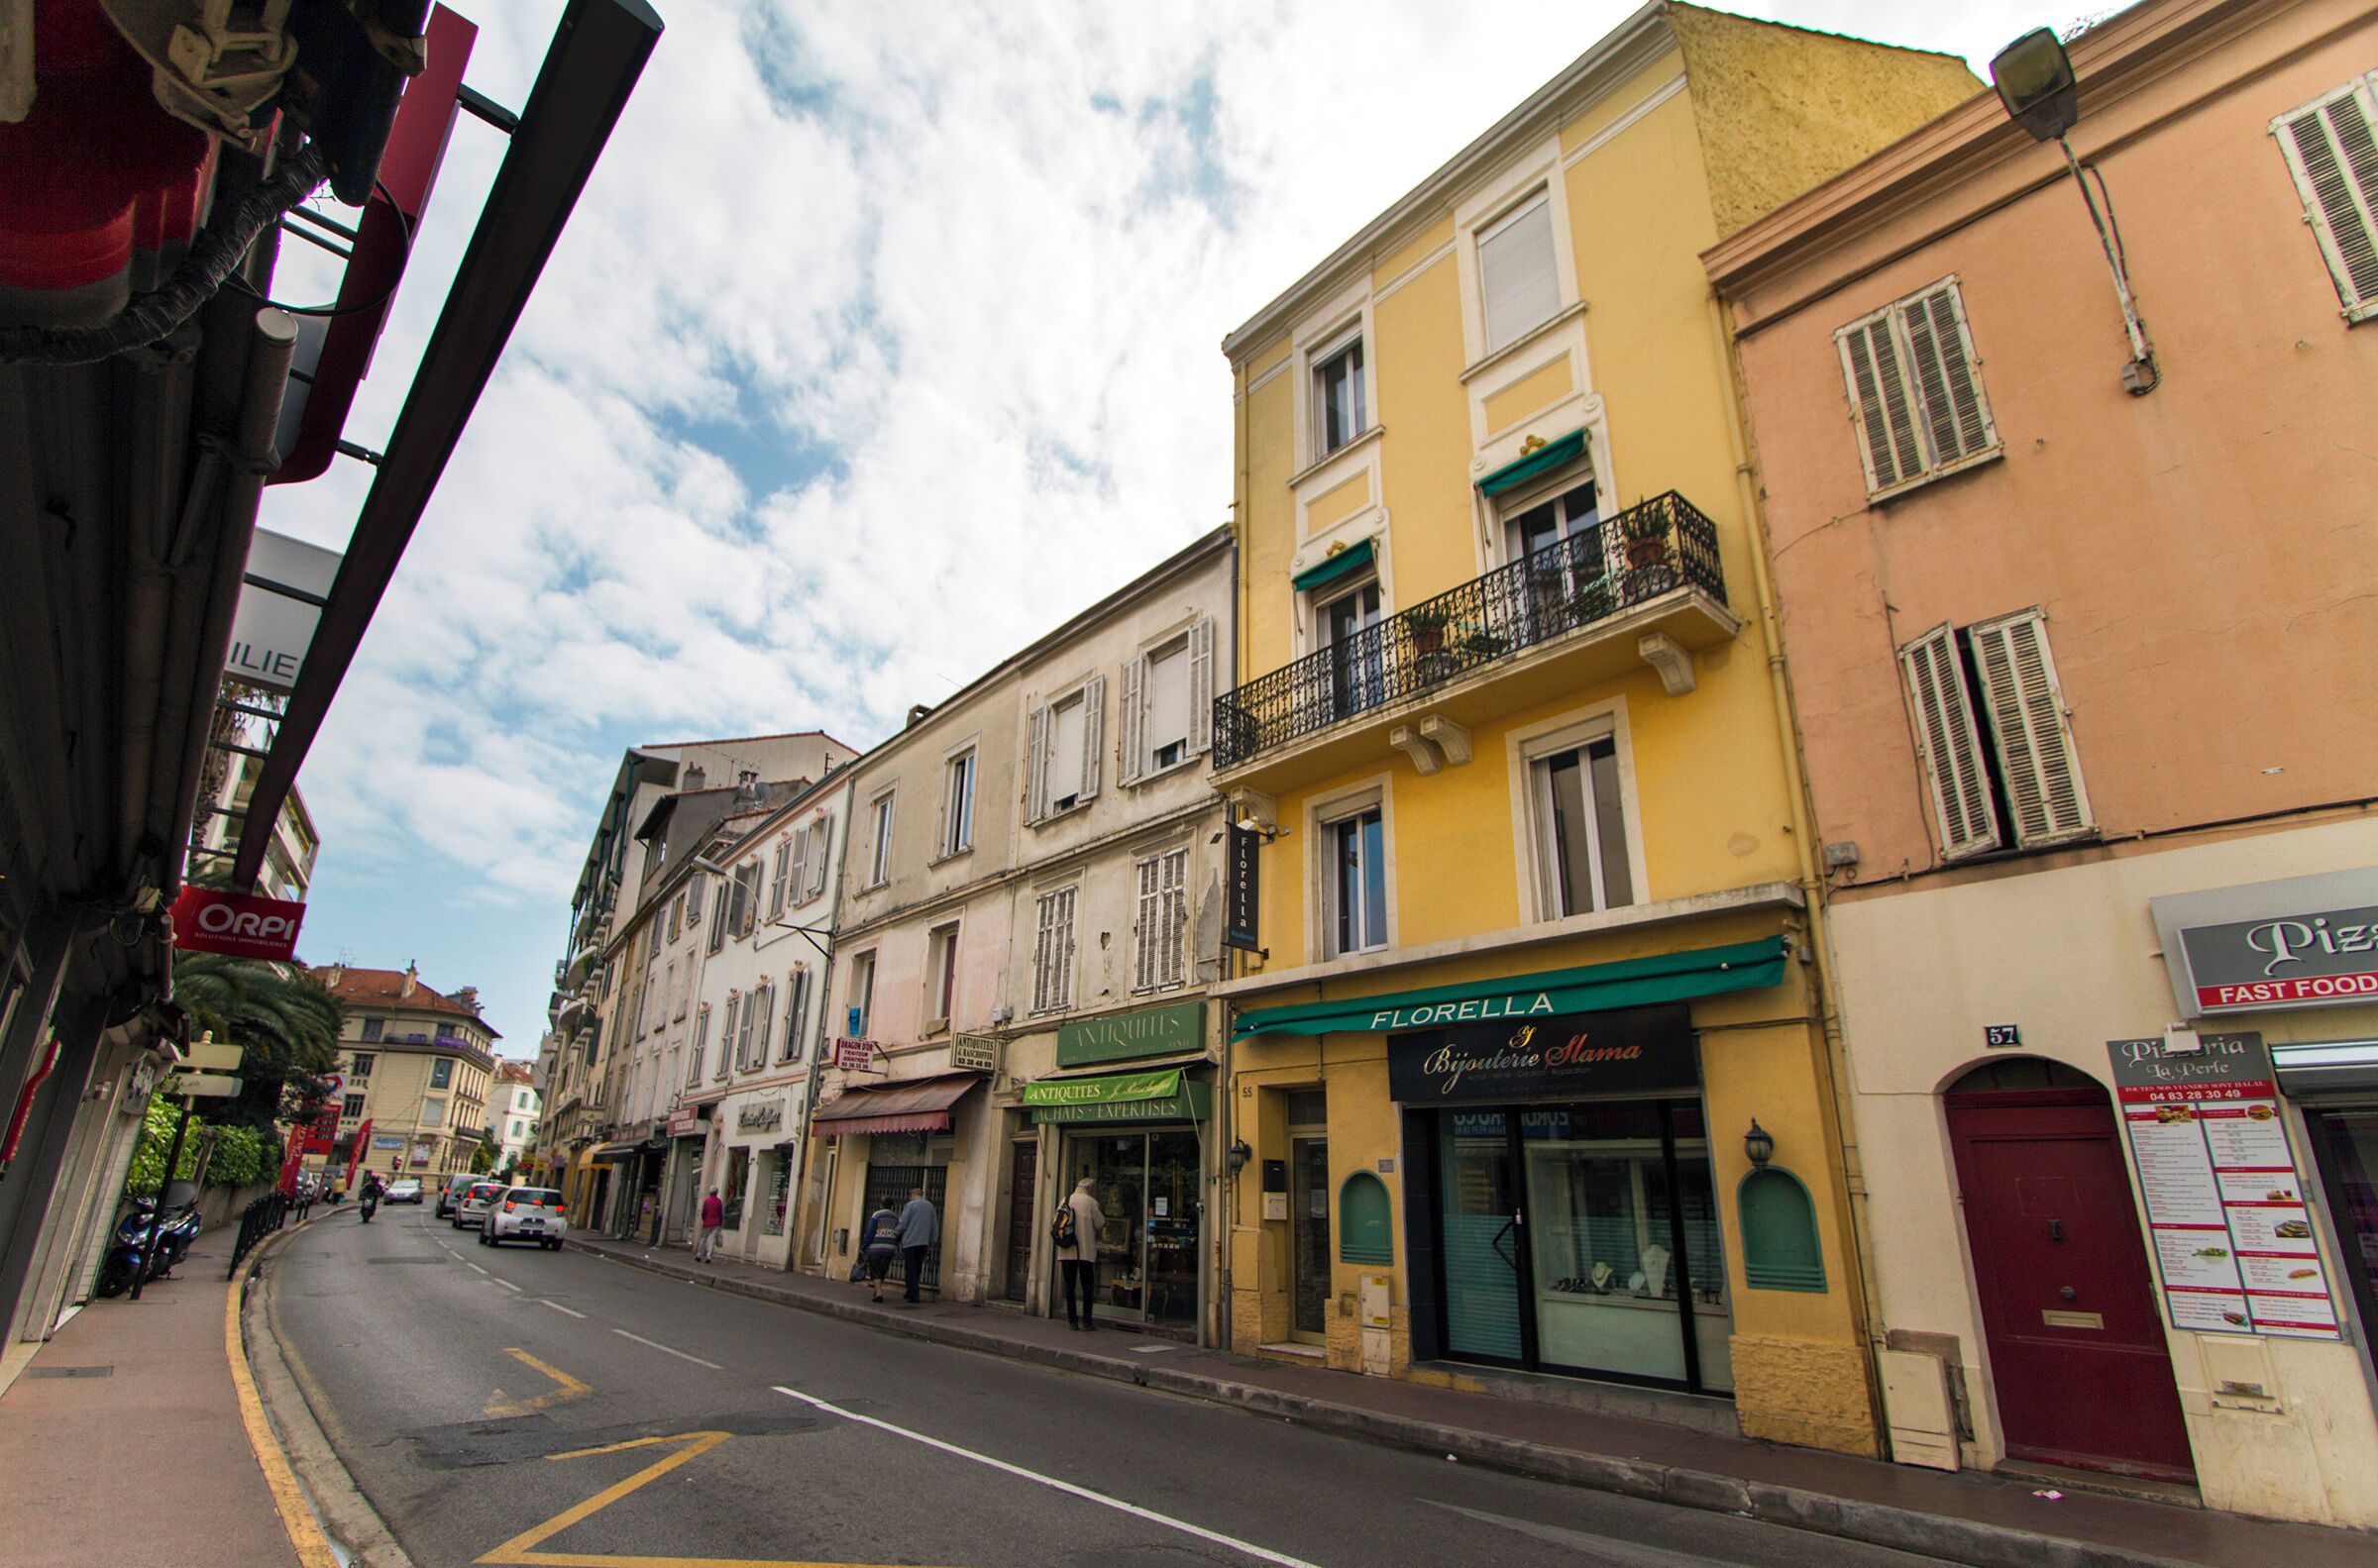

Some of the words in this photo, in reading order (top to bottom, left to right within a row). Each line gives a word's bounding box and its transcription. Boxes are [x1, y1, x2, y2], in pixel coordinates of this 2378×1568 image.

[1239, 837, 1248, 927] Florella
[199, 903, 296, 940] ORPI
[195, 932, 237, 942] SOLUTIONS
[2219, 983, 2287, 1003] FAST
[2295, 975, 2378, 996] FOOD
[1370, 992, 1555, 1029] FLORELLA
[957, 1035, 994, 1051] ANTIQUITES
[1990, 1027, 2015, 1045] 57
[841, 1040, 861, 1050] DRAGON
[862, 1041, 873, 1052] D'OR
[1423, 1043, 1540, 1095] Bijouterie
[1544, 1033, 1643, 1070] Slama
[2146, 1063, 2175, 1081] La
[2176, 1061, 2229, 1080] Perle
[1243, 1087, 1252, 1098] 55
[2234, 1079, 2266, 1088] HALAL
[1031, 1085, 1101, 1103] ANTIQUITES
[2150, 1092, 2165, 1101] 04
[2168, 1091, 2183, 1100] 83
[2187, 1091, 2202, 1099] 28
[2206, 1090, 2220, 1098] 30
[2224, 1089, 2241, 1098] 49
[1036, 1106, 1085, 1121] ACHATS
[1097, 1099, 1177, 1119] EXPERTISES
